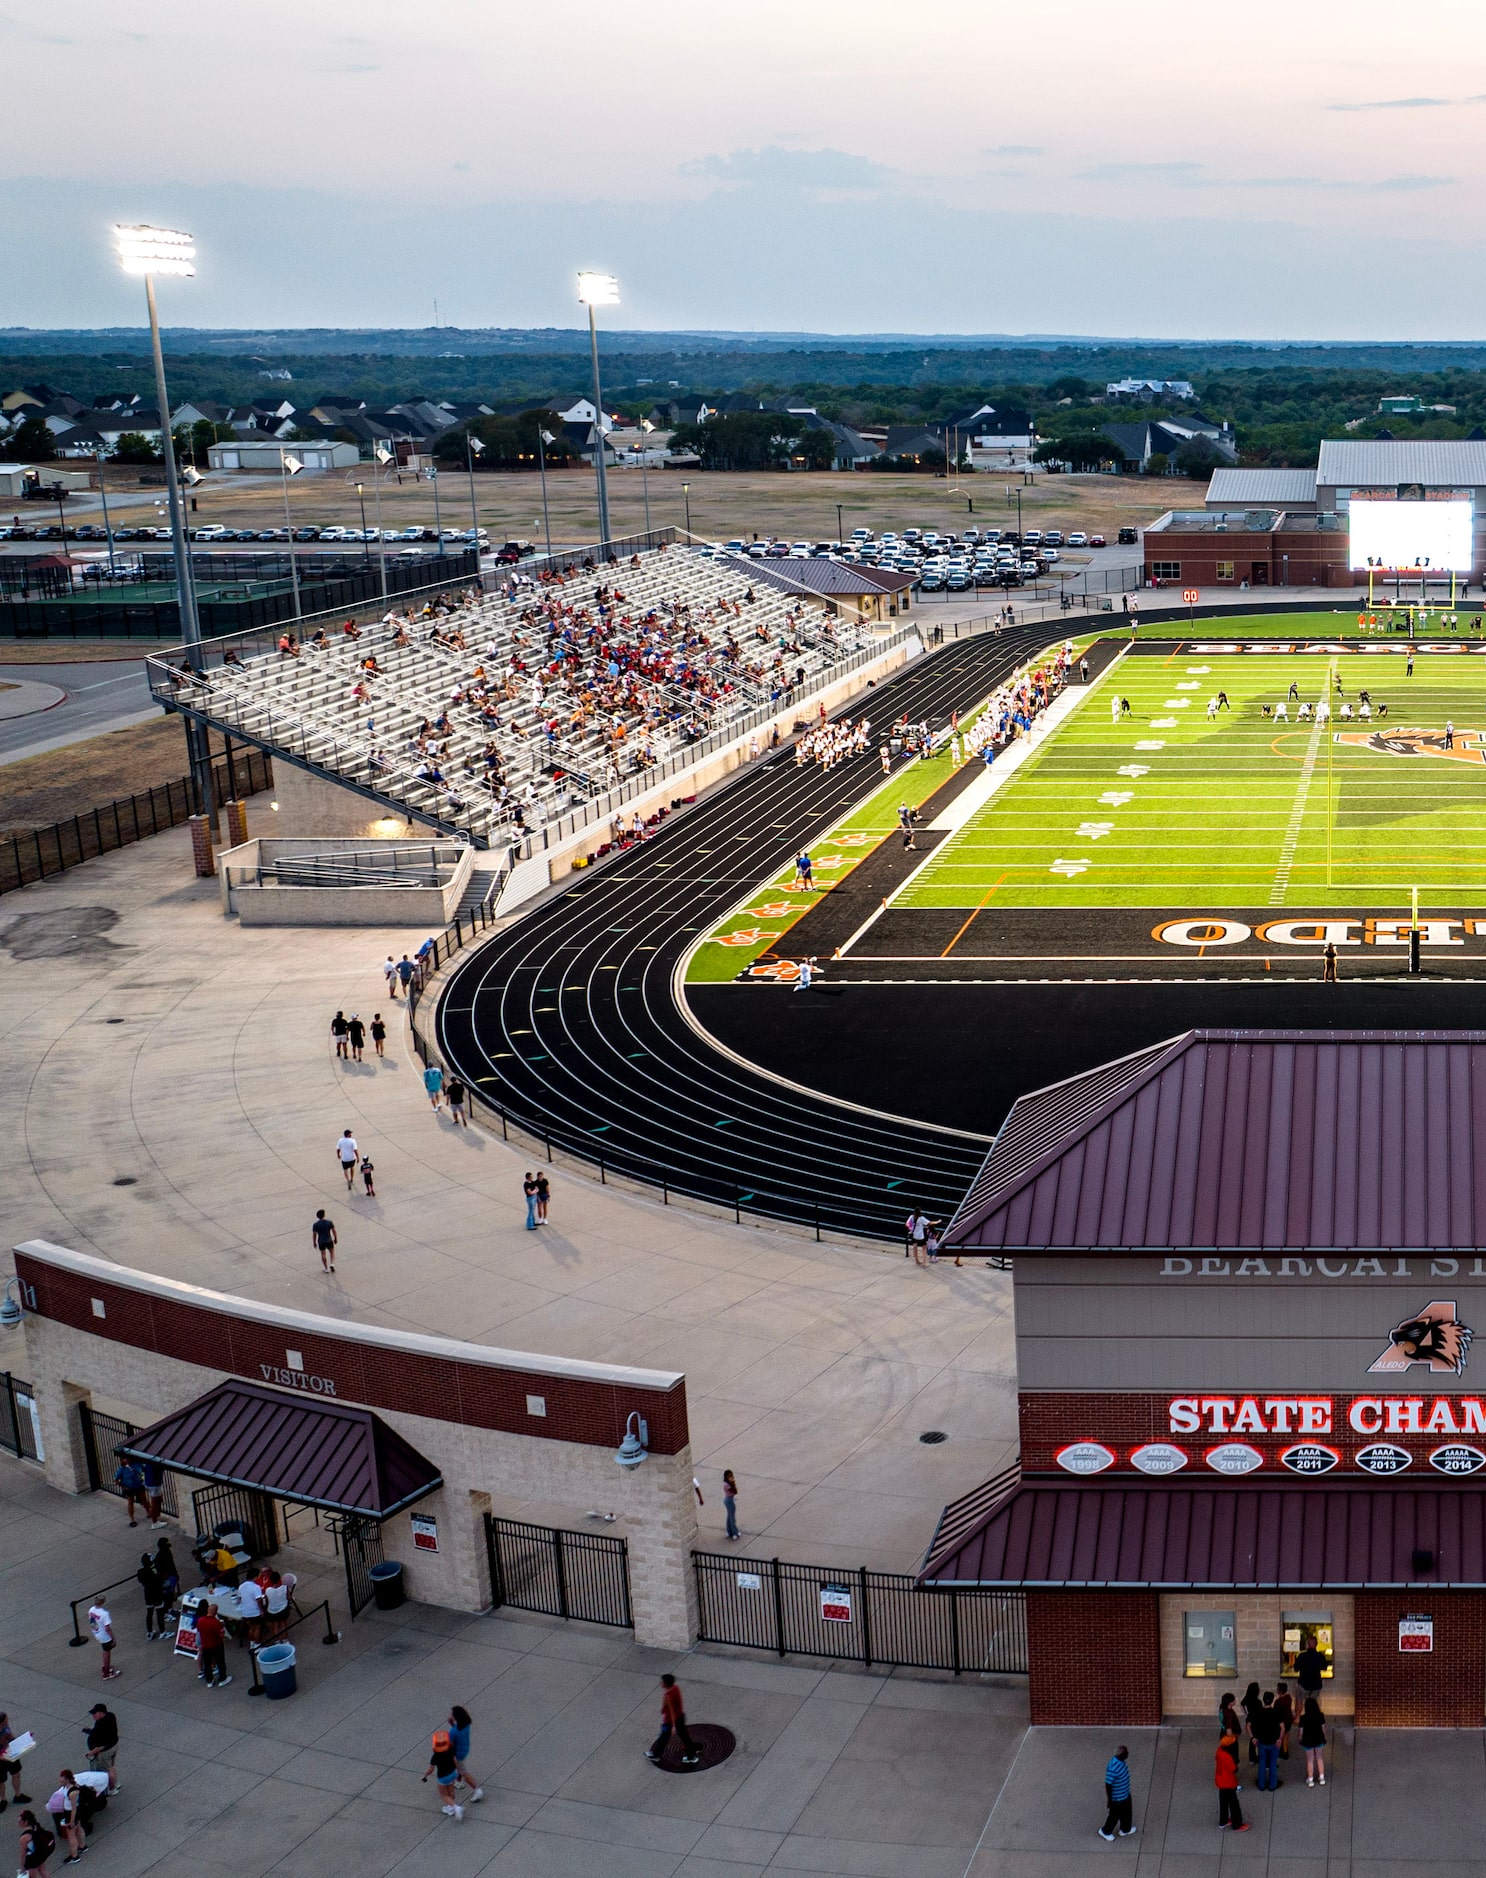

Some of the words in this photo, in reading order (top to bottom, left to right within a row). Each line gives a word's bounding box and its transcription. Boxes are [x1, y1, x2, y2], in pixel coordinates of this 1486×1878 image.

[1183, 591, 1198, 601] 00
[1048, 859, 1093, 873] 10
[1375, 1361, 1405, 1369] ALEDO
[259, 1363, 337, 1396] VISITOR
[1169, 1399, 1332, 1434] STATE
[1070, 1460, 1100, 1469] 1998
[1144, 1460, 1174, 1470] 2009
[1220, 1460, 1250, 1470] 2010
[1296, 1460, 1321, 1469] 2011
[1370, 1460, 1396, 1469] 2013
[1444, 1460, 1472, 1470] 2014
